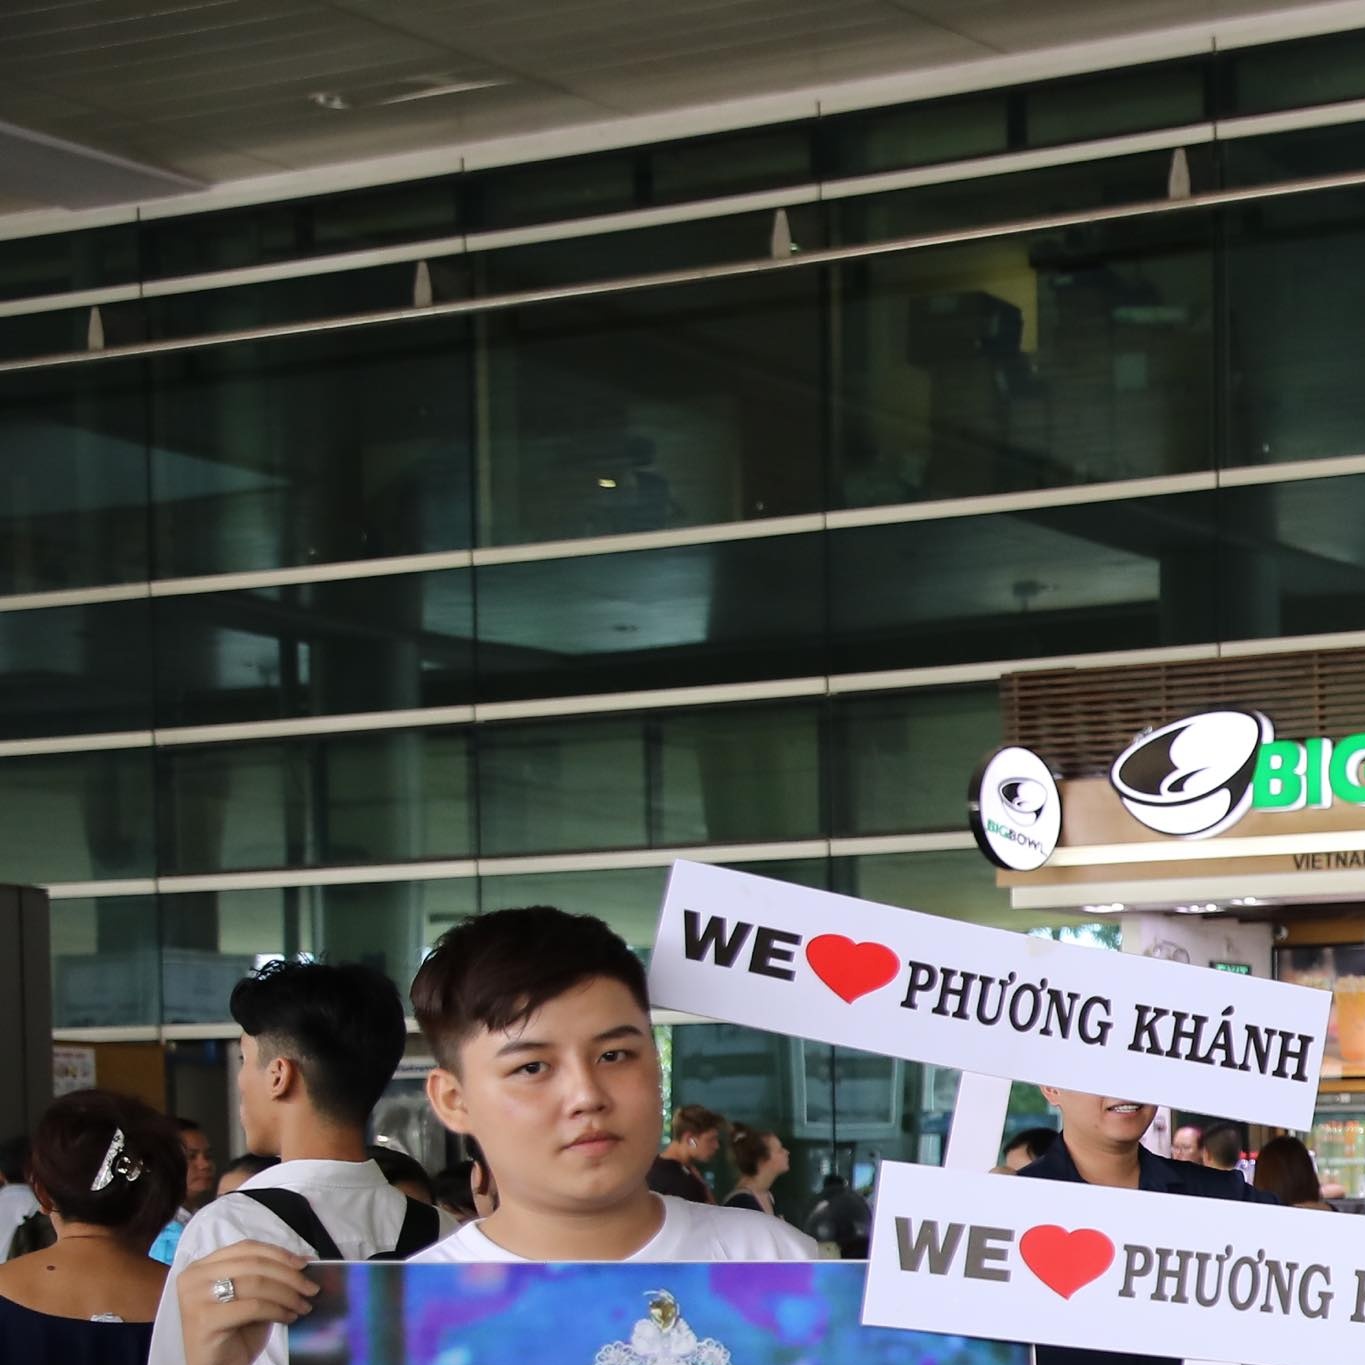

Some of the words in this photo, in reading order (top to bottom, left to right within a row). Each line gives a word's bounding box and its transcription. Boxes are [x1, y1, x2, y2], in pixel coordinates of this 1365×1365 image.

[682, 909, 803, 982] WE
[899, 959, 1114, 1046] PHƯƠNG
[1127, 1004, 1314, 1083] KHÁNH
[895, 1213, 1016, 1283] WE
[1117, 1243, 1333, 1321] PHƯƠNG
